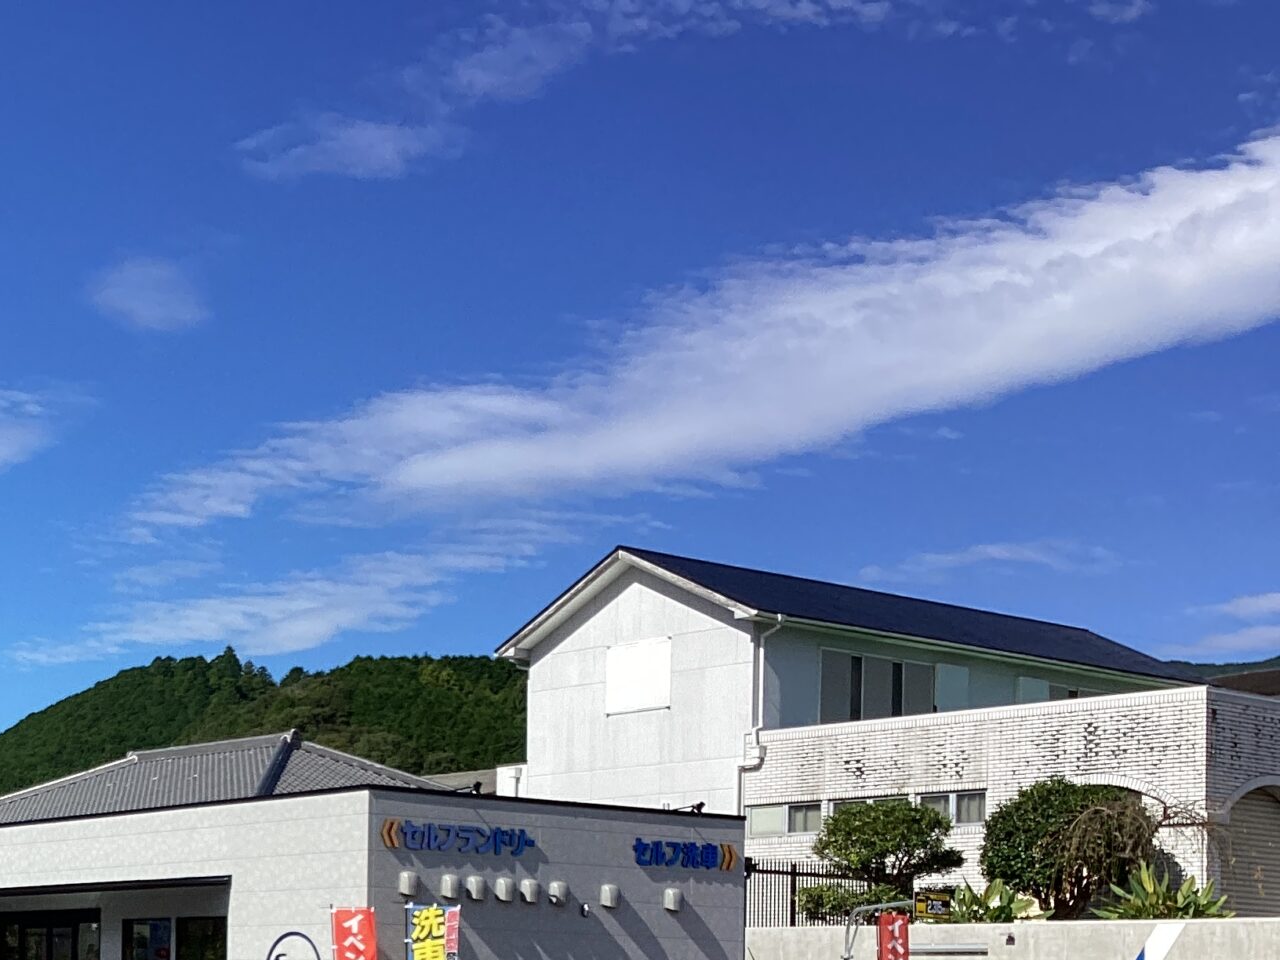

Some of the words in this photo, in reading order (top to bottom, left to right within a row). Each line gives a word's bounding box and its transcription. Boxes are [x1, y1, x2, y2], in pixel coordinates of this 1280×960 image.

[401, 819, 535, 857] セルフランドリー
[633, 837, 719, 869] セルフ洗車
